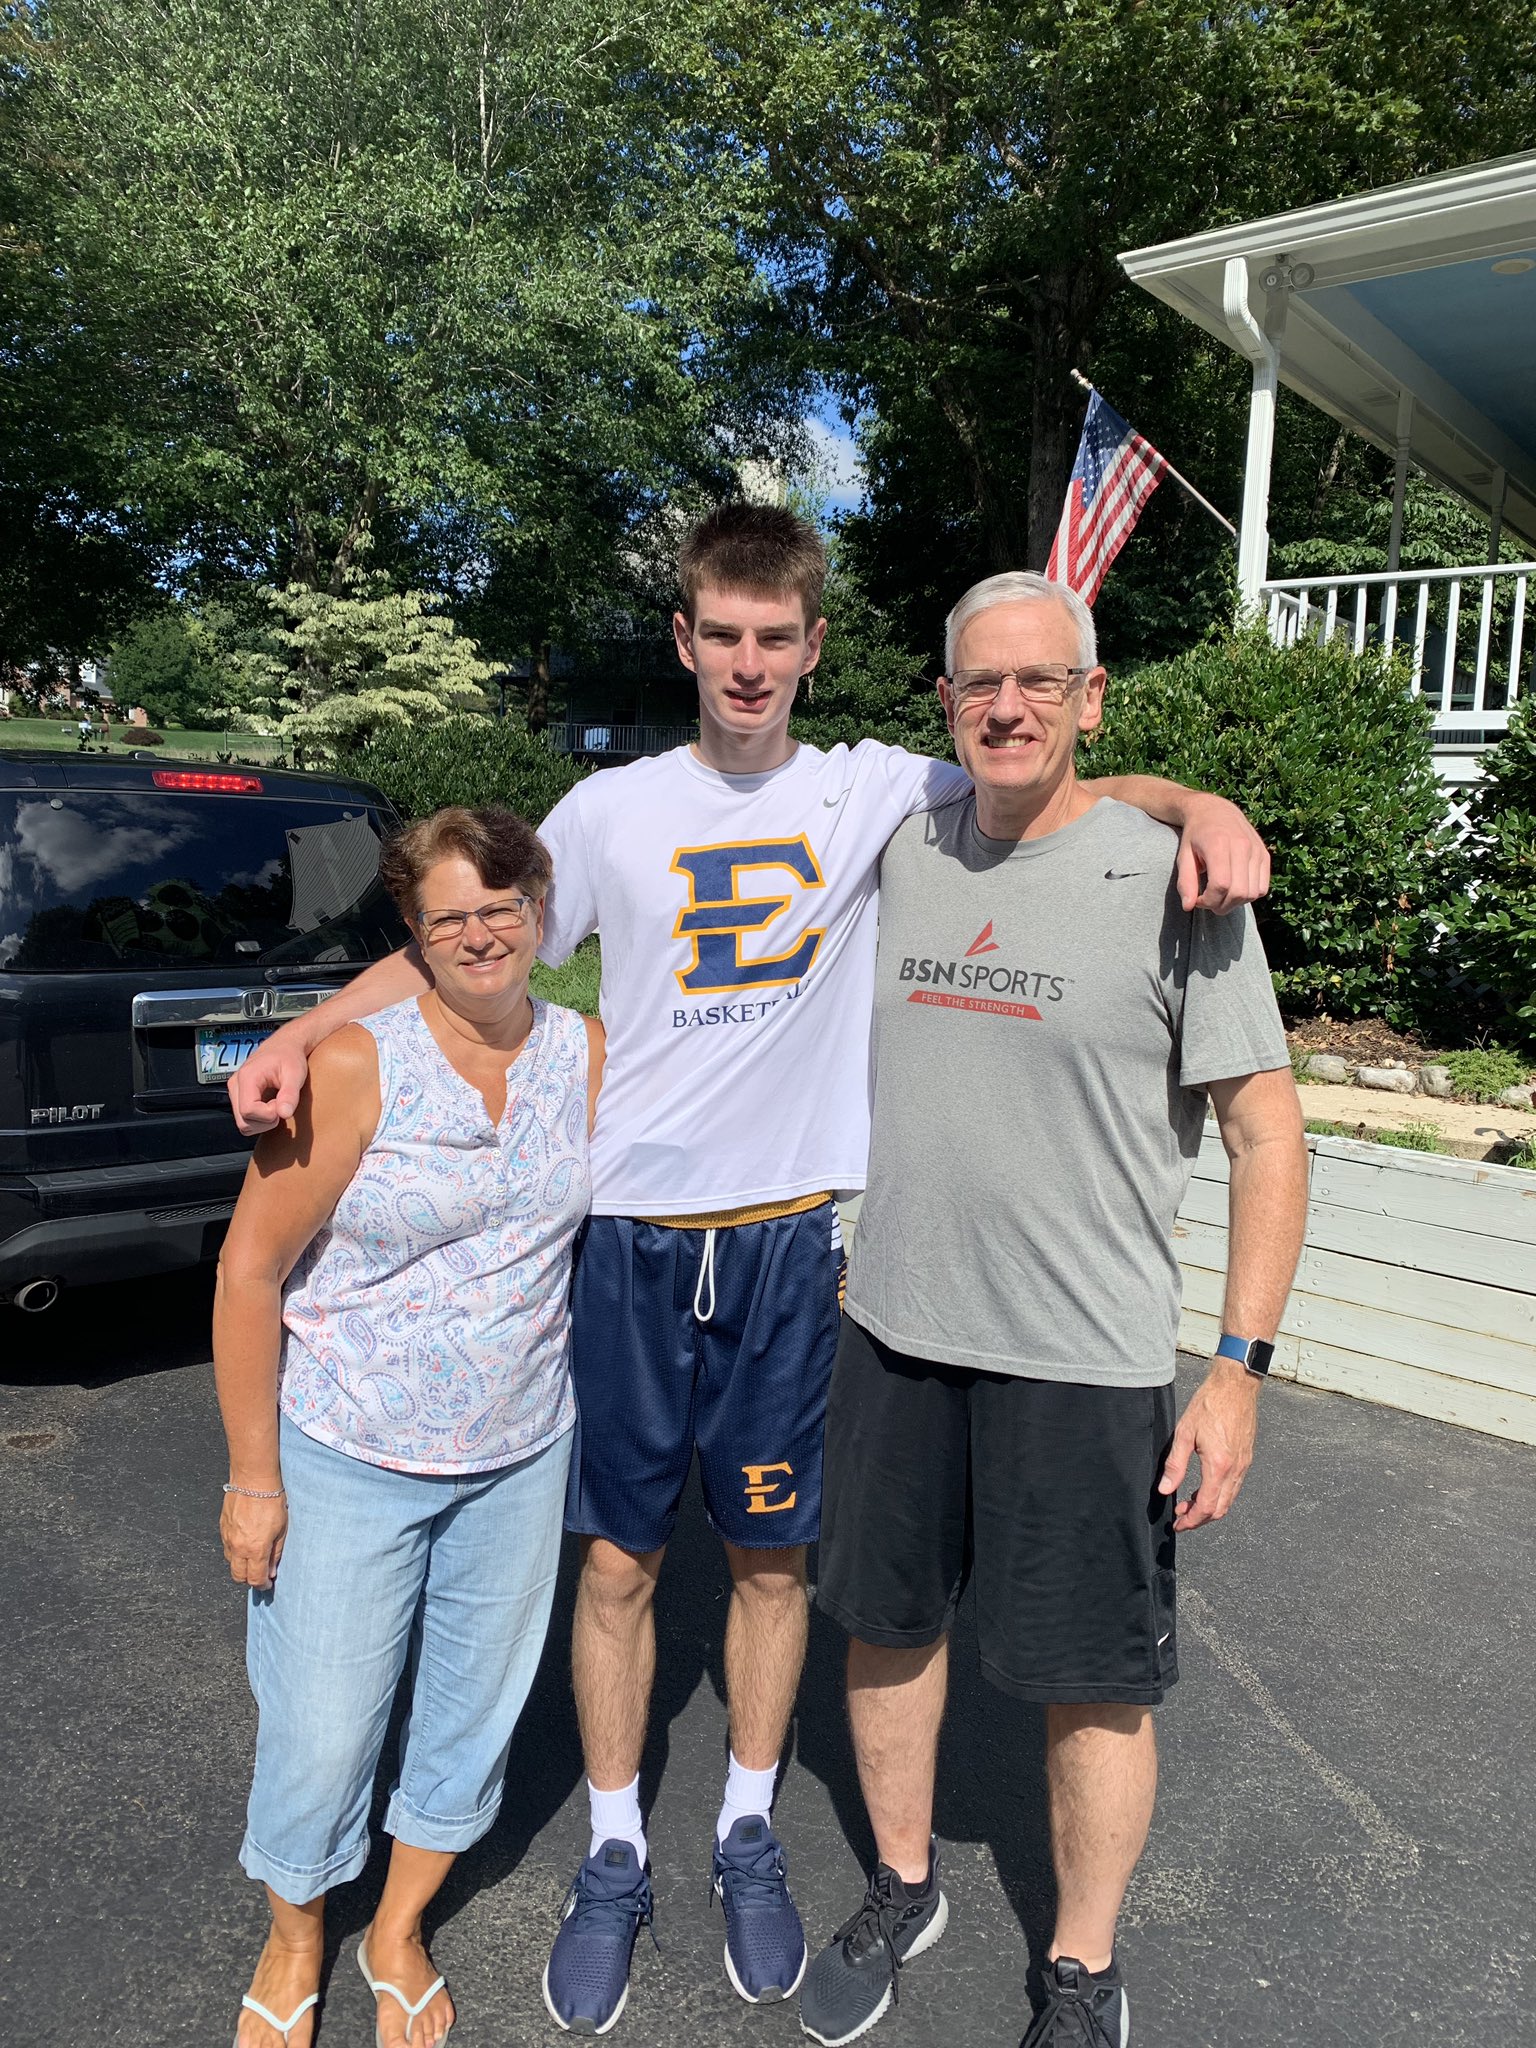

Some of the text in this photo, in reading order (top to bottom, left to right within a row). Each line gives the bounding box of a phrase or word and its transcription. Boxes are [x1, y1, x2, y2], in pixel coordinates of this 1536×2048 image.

[921, 992, 1025, 1016] FEEL THE STRENGTH
[204, 1031, 214, 1039] 12
[31, 1104, 105, 1124] PILOT
